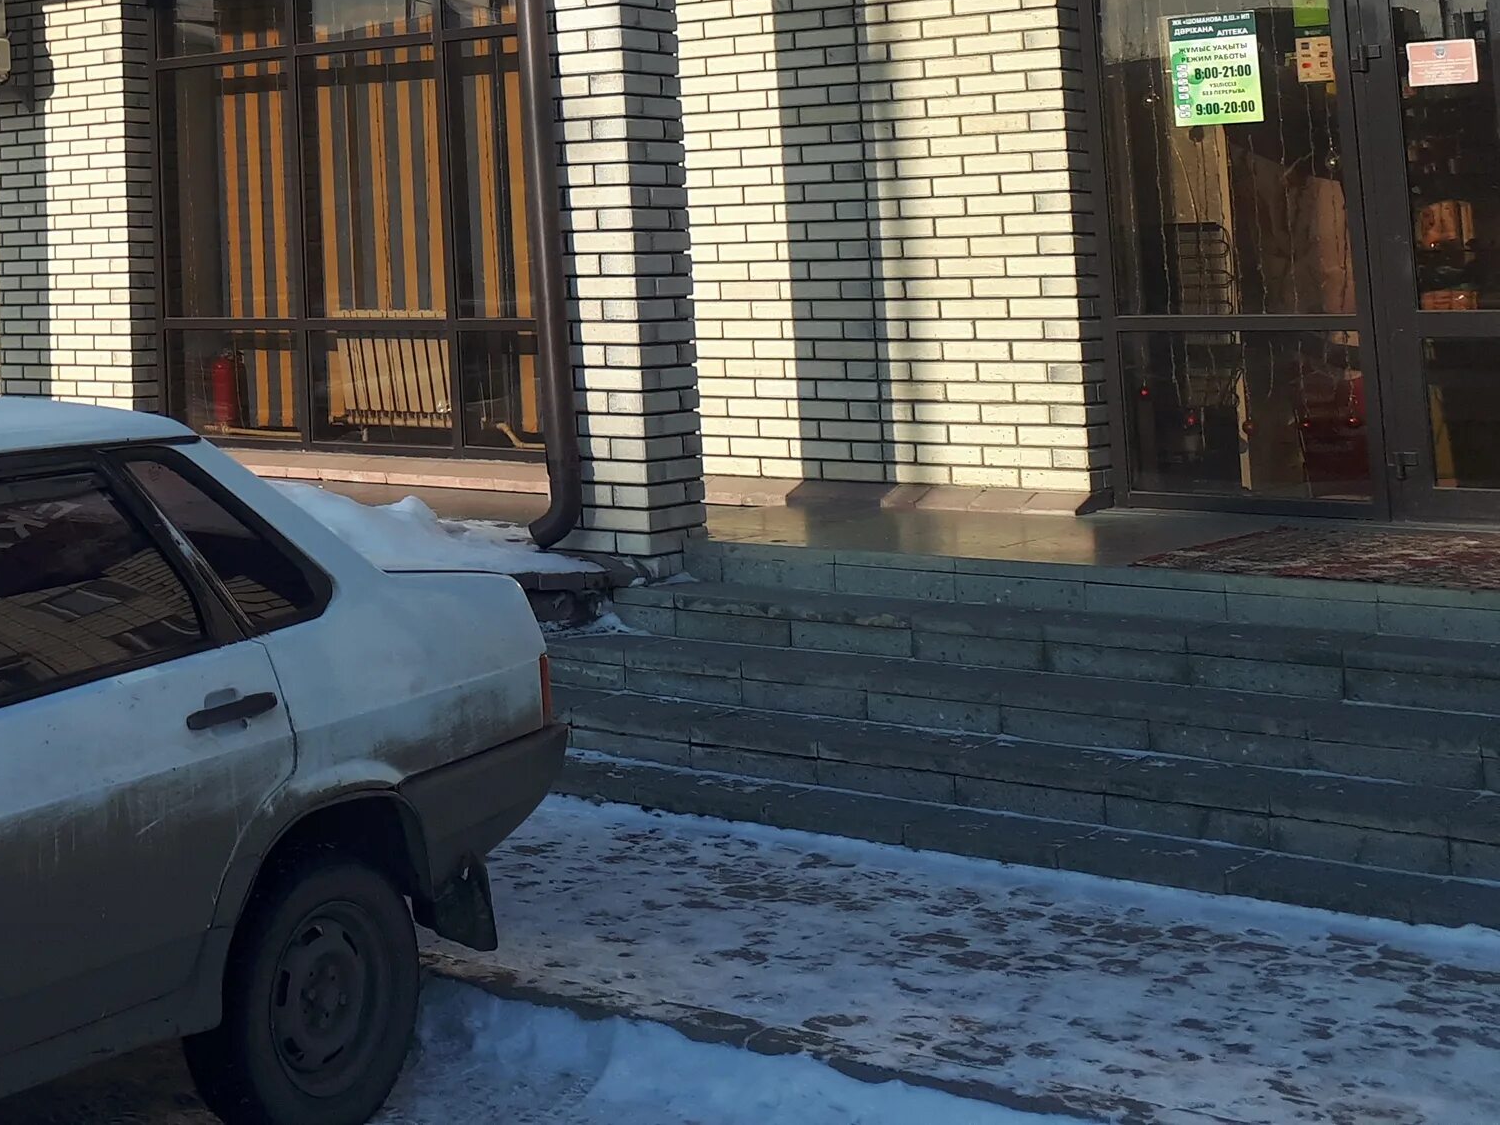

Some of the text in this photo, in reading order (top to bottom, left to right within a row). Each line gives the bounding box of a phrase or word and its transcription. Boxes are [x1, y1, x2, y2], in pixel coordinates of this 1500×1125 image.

[1174, 26, 1214, 36] ДӘРІХАНА
[1216, 28, 1248, 36] АПТЕКА
[1212, 43, 1248, 52] УАҚЫТЫ
[1181, 53, 1247, 63] РЕЖИМ РАБОТЫ
[1194, 64, 1251, 80] 8:00-21:00
[1196, 100, 1255, 115] 9:00-20:00
